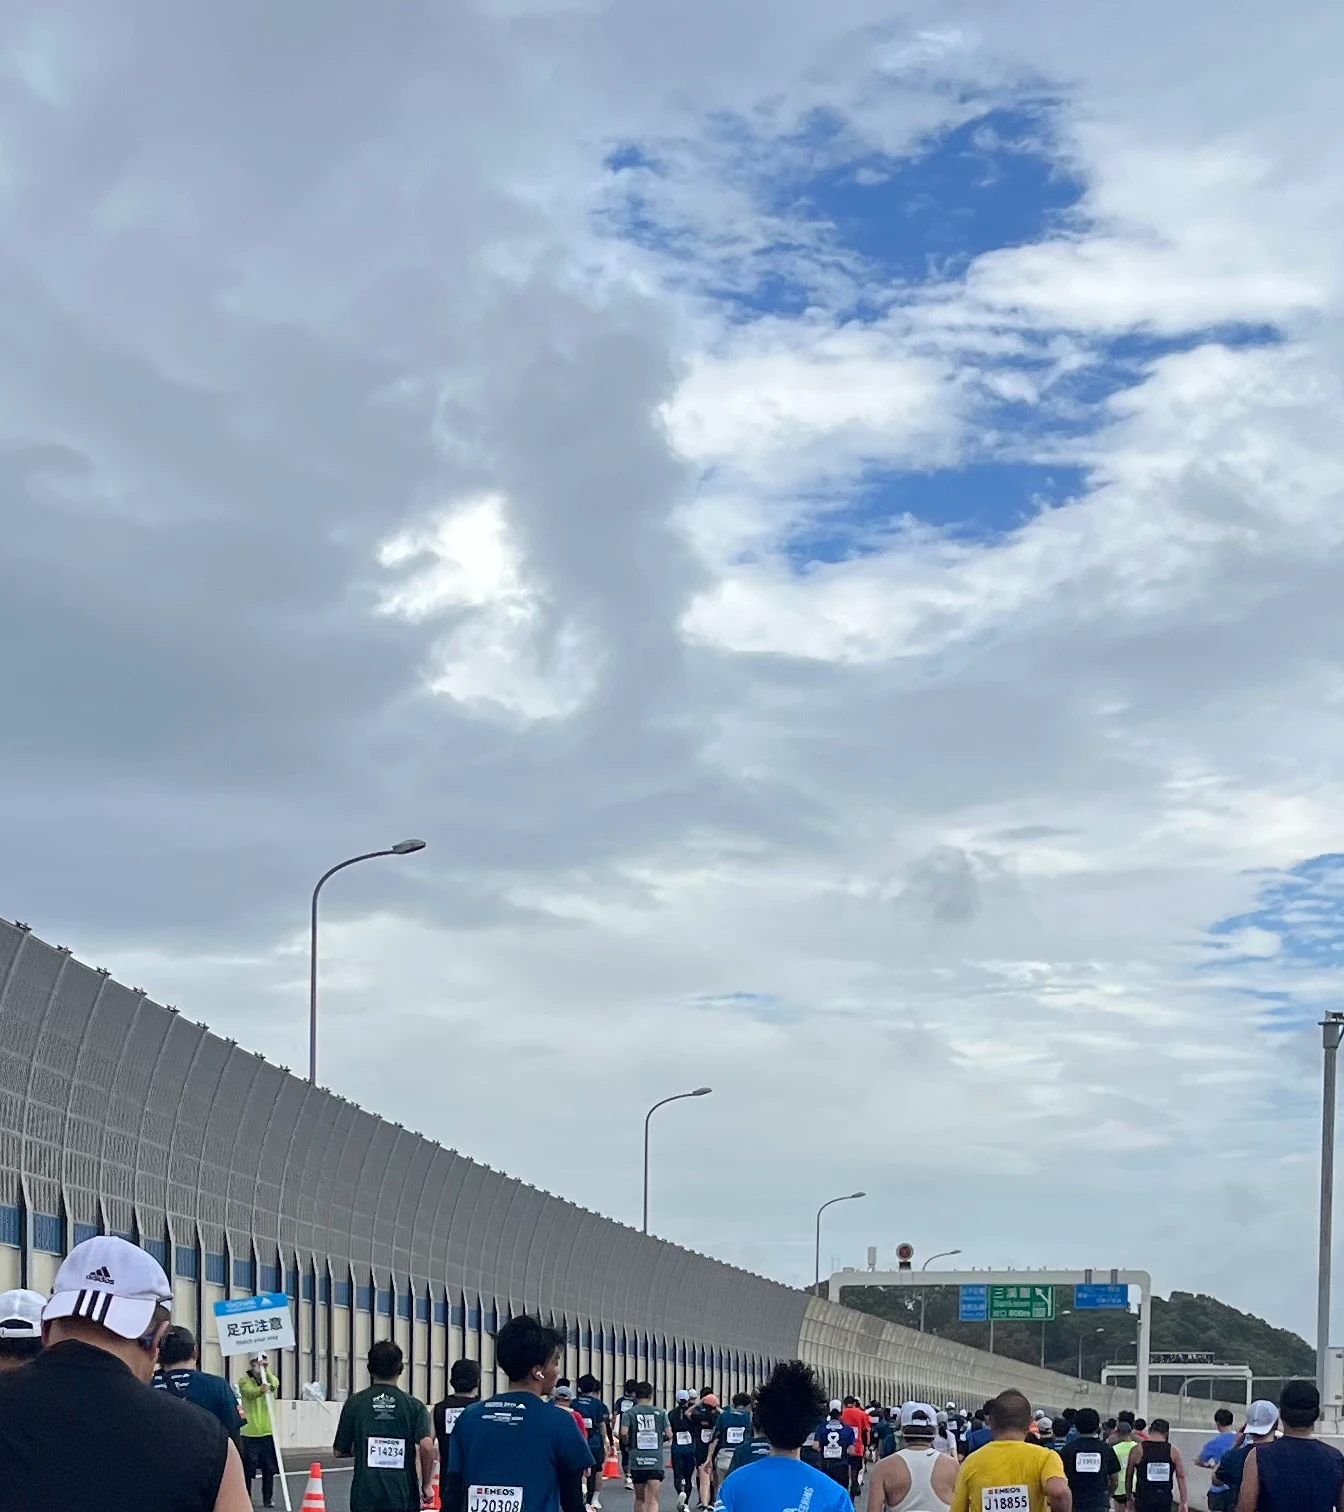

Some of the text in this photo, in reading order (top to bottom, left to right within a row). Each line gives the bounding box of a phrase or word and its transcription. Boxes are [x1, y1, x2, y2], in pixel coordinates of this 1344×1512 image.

[227, 1317, 282, 1337] 足元注意
[985, 1496, 1028, 1510] J18855
